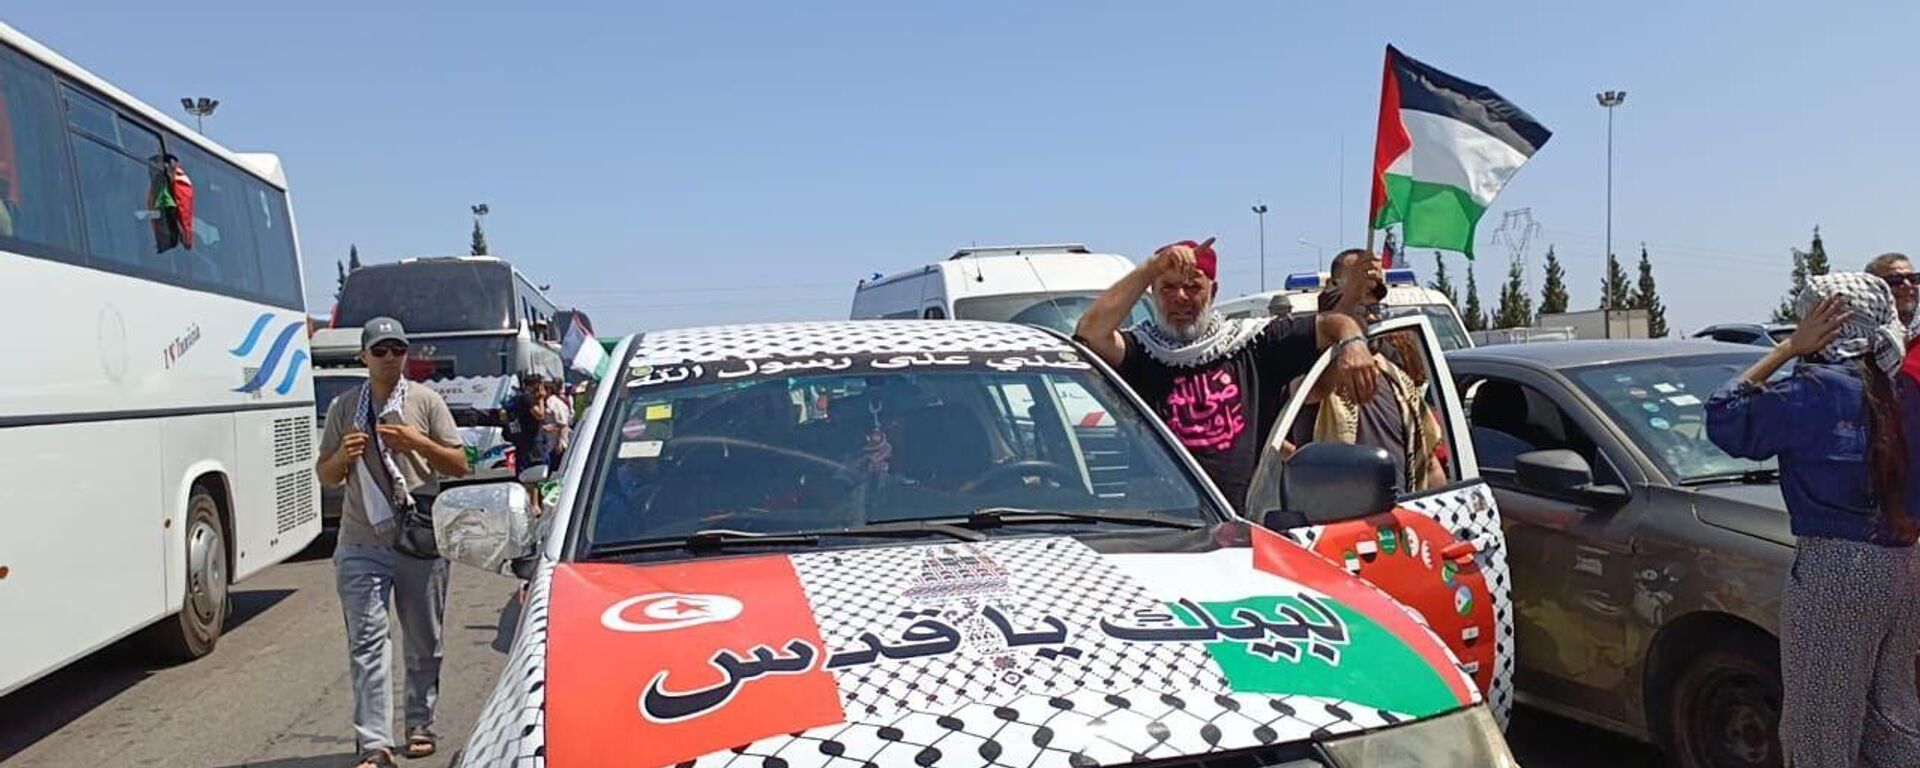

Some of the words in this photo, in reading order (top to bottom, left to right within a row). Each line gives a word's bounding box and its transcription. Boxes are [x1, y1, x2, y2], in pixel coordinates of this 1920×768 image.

[626, 363, 703, 388] الله
[717, 357, 852, 379] رسول
[870, 351, 972, 369] على
[980, 605, 1081, 661] يا
[1098, 591, 1349, 665] لبيك
[641, 609, 962, 722] قدس
